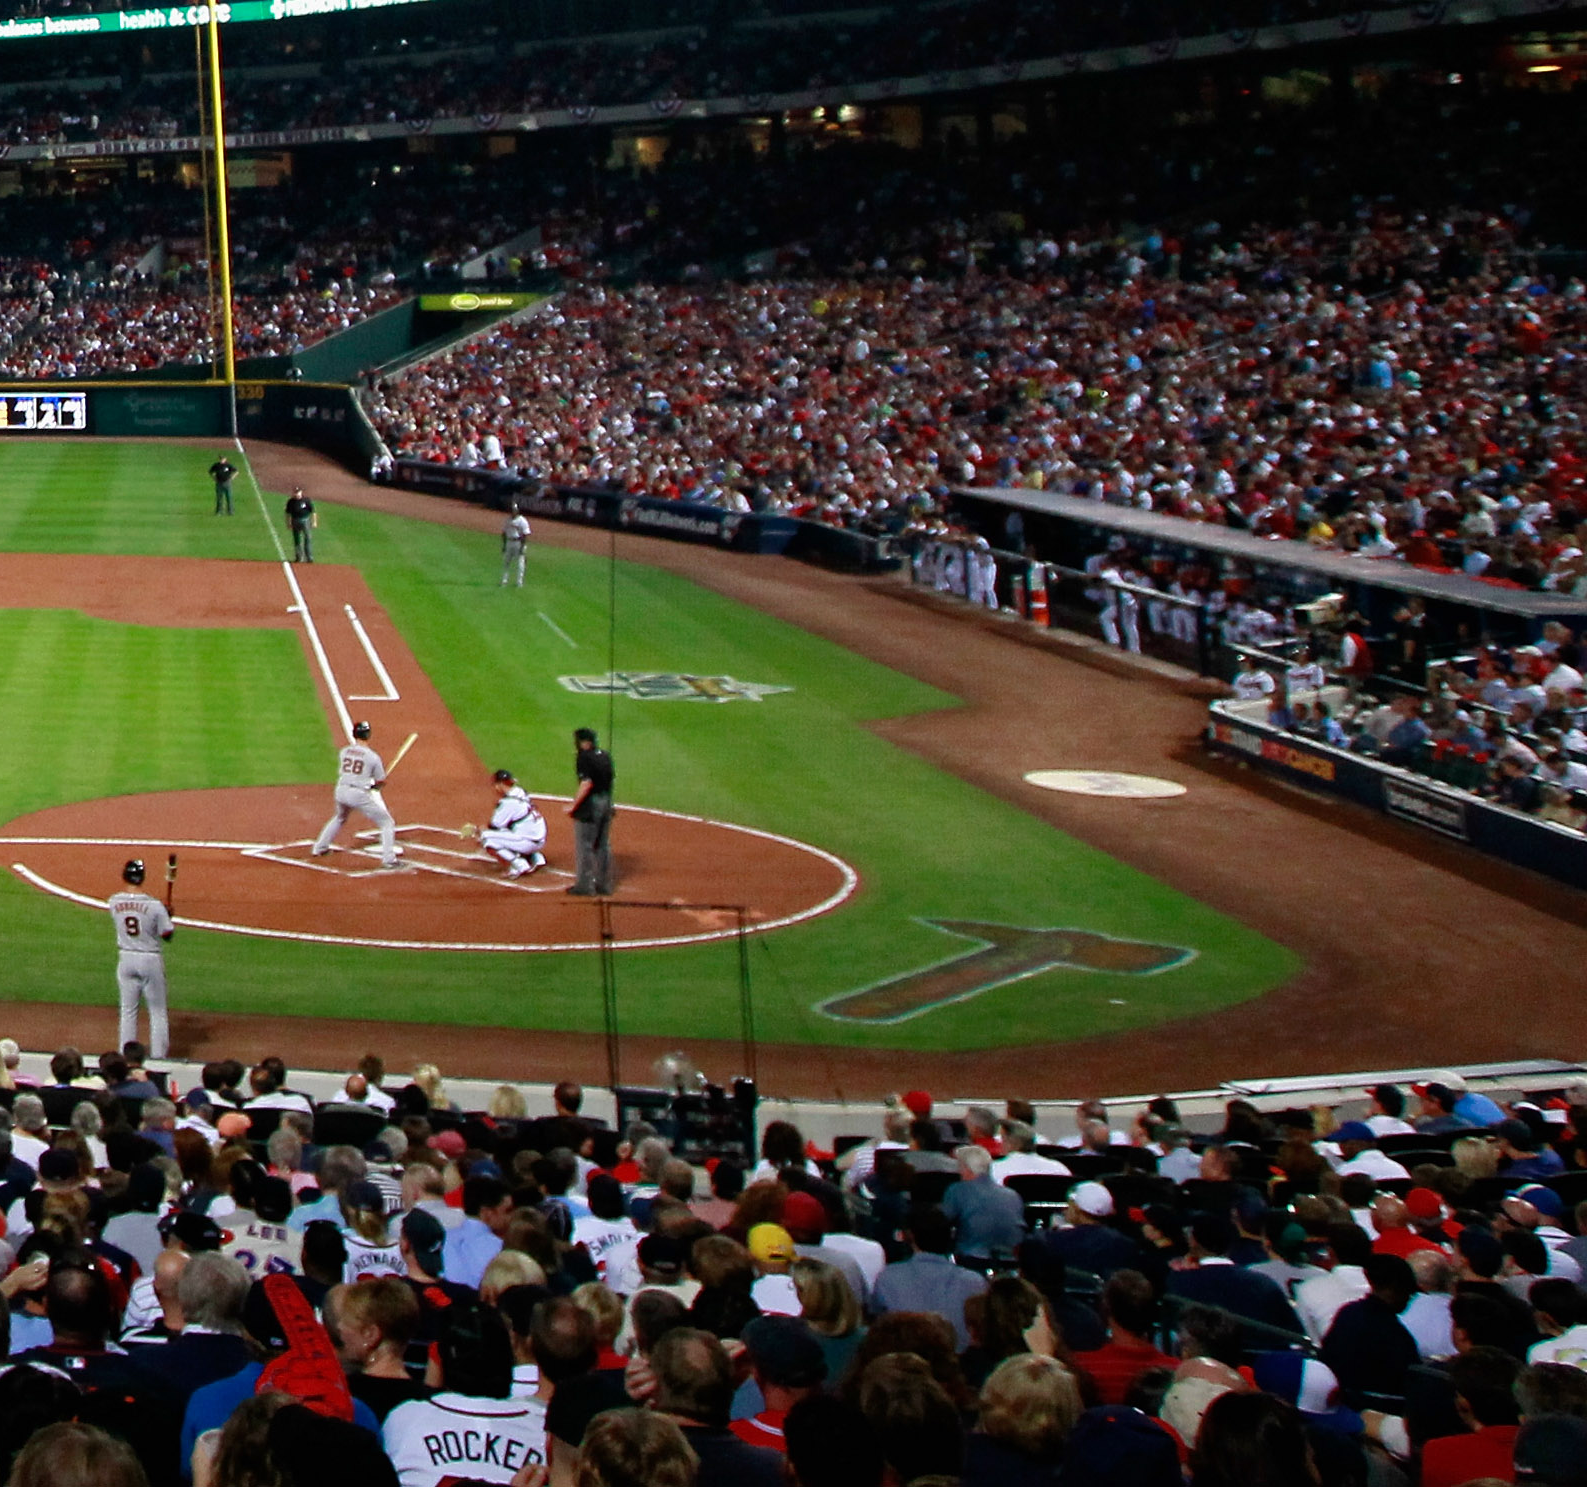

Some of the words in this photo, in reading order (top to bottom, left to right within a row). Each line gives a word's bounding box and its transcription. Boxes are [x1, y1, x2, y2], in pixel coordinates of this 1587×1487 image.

[44, 14, 100, 36] between
[119, 7, 167, 30] health
[342, 758, 365, 775] 28
[124, 916, 141, 937] 9
[247, 1224, 288, 1241] LEE
